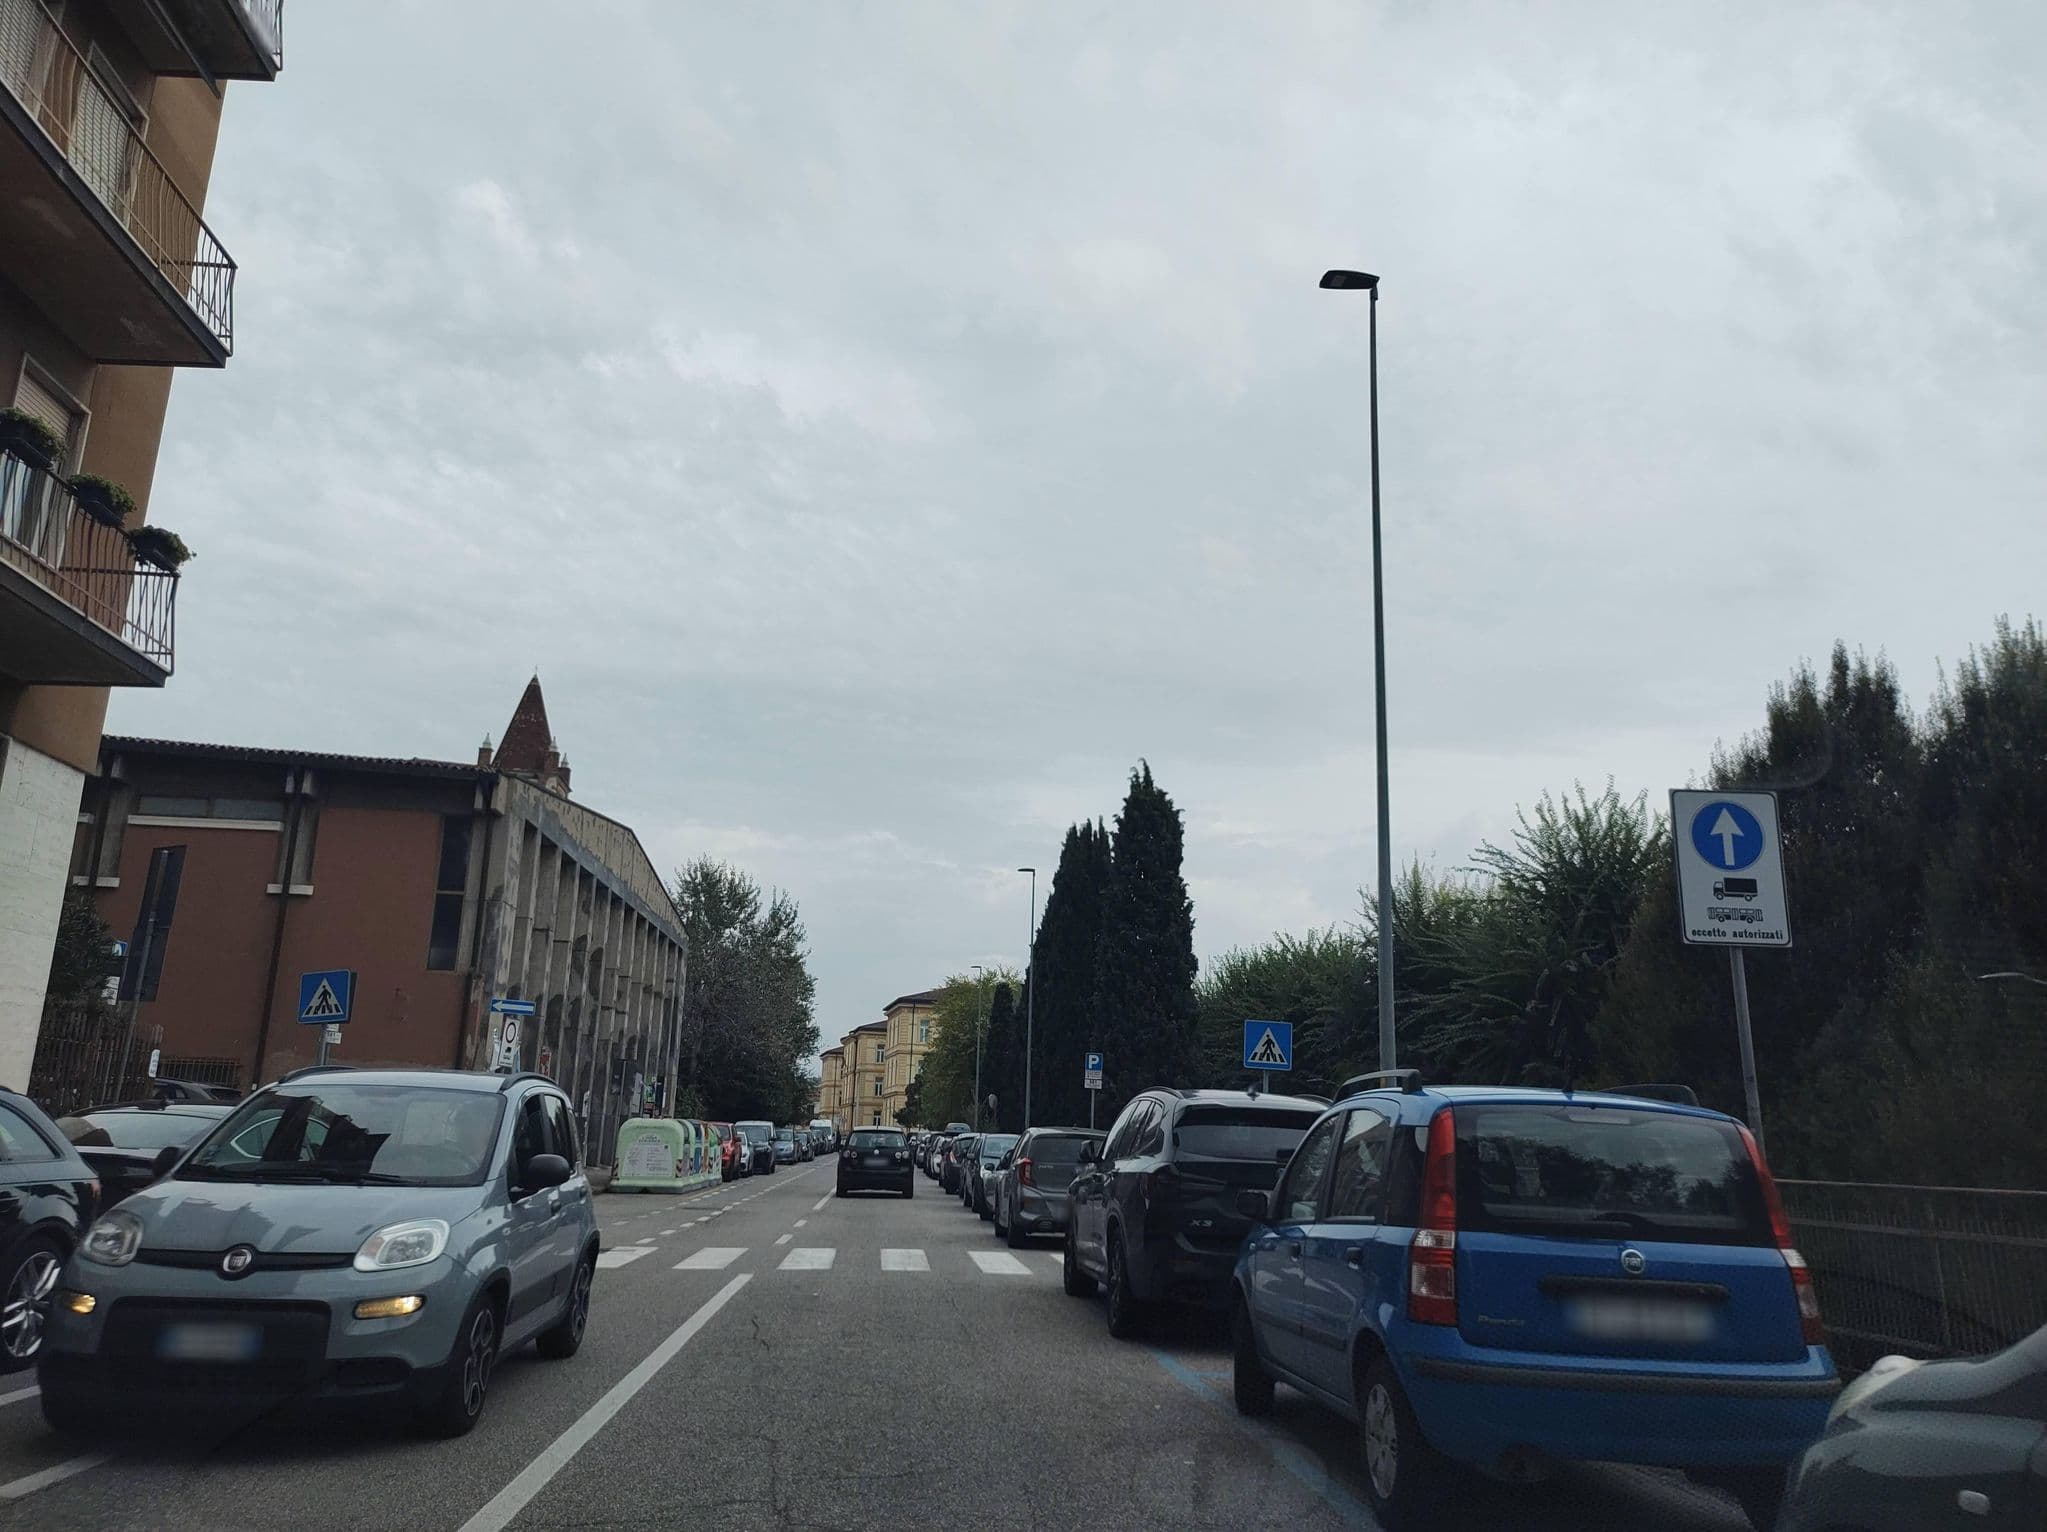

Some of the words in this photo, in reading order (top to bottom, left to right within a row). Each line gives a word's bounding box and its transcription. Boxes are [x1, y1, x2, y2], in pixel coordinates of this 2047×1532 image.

[1692, 928, 1727, 938] eccetto
[1732, 929, 1784, 940] autorizzati
[1088, 1055, 1099, 1069] P
